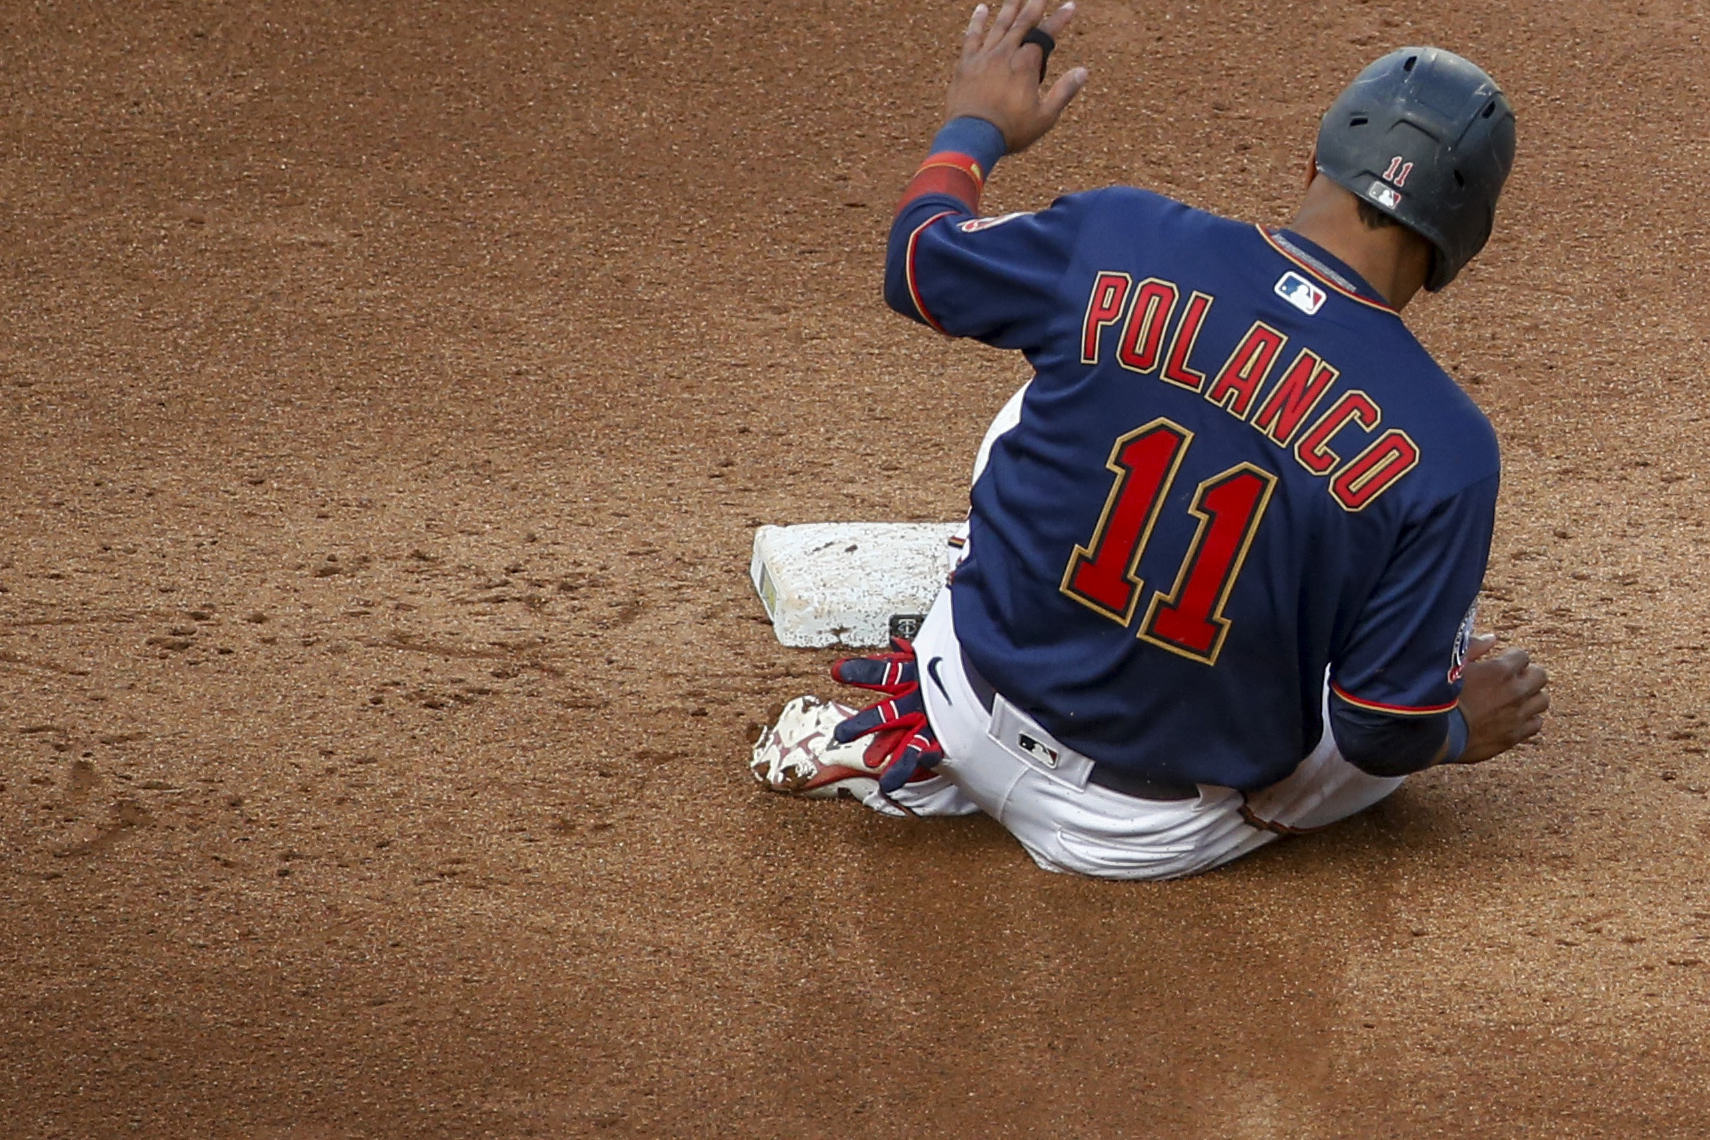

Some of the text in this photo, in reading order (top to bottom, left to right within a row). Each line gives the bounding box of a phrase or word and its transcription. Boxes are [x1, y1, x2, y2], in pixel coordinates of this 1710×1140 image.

[1382, 156, 1414, 188] 11
[1081, 270, 1420, 511] POLANCO
[1059, 416, 1278, 666] 11
